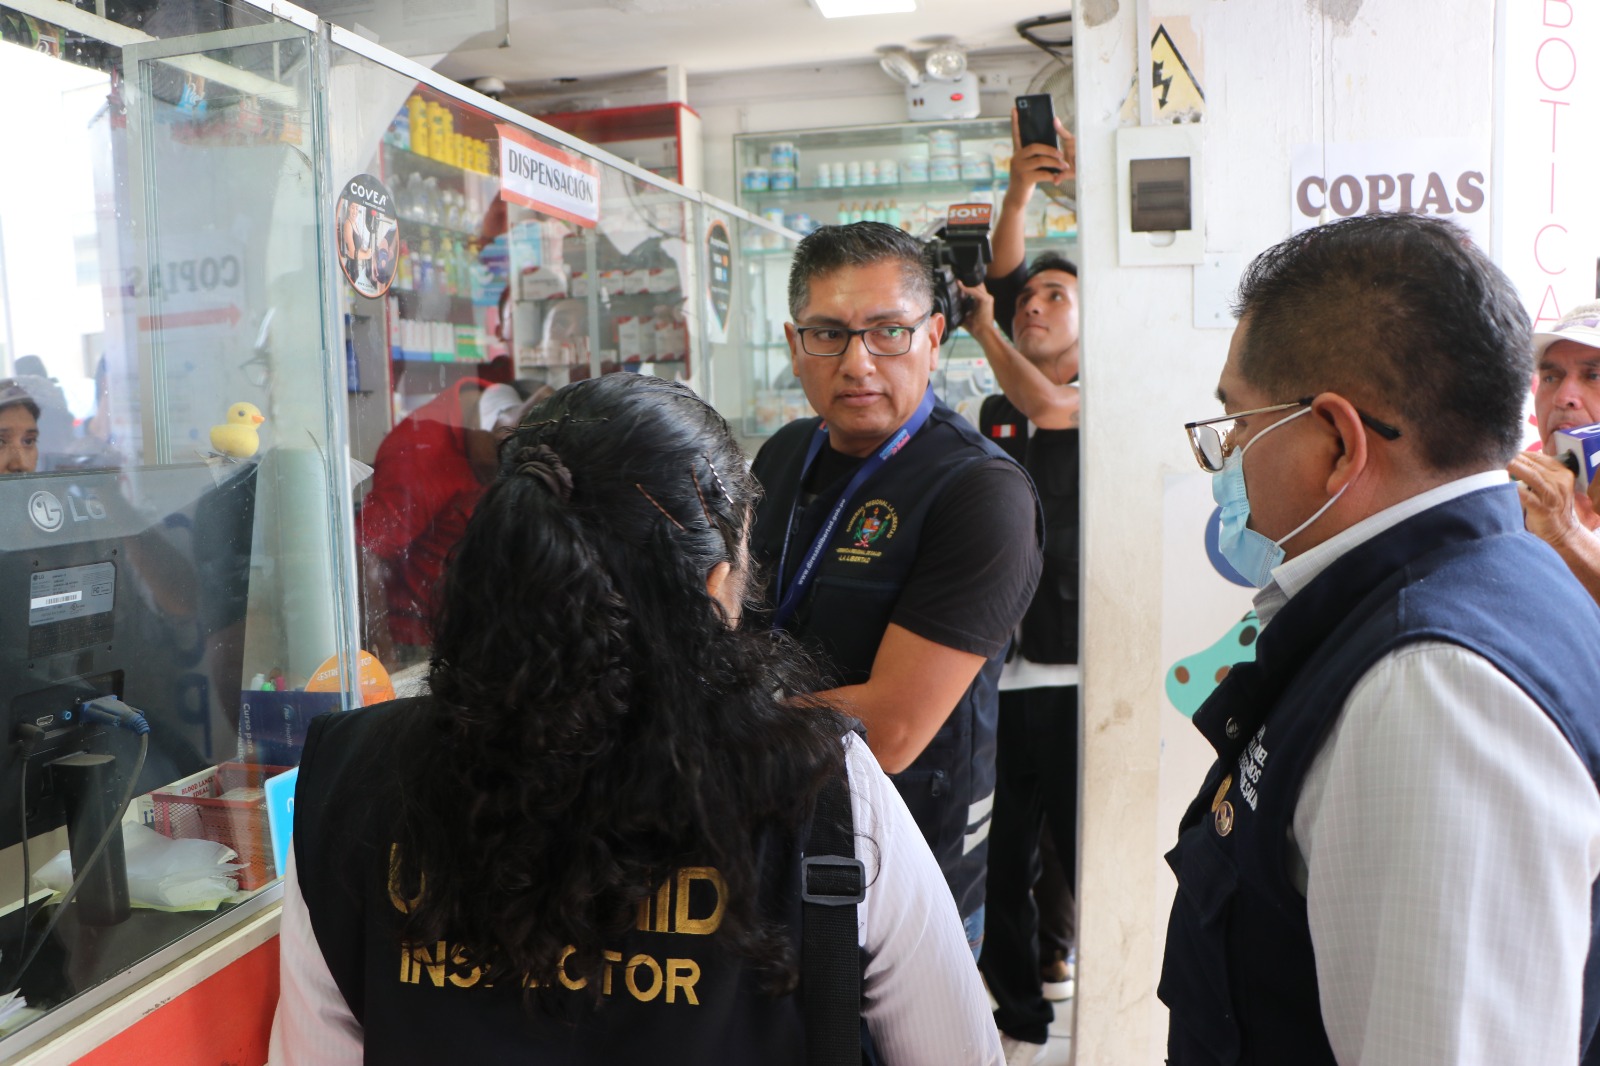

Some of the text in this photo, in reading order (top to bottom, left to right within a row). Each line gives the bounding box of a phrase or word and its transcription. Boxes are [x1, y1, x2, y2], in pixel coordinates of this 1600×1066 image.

[508, 148, 594, 203] DISPENSACIÓN
[1296, 170, 1485, 217] COPIAS
[67, 494, 107, 522] LG
[243, 703, 254, 754] Curso para
[181, 783, 199, 795] BLOOD
[400, 940, 701, 1006] INSCTOR
